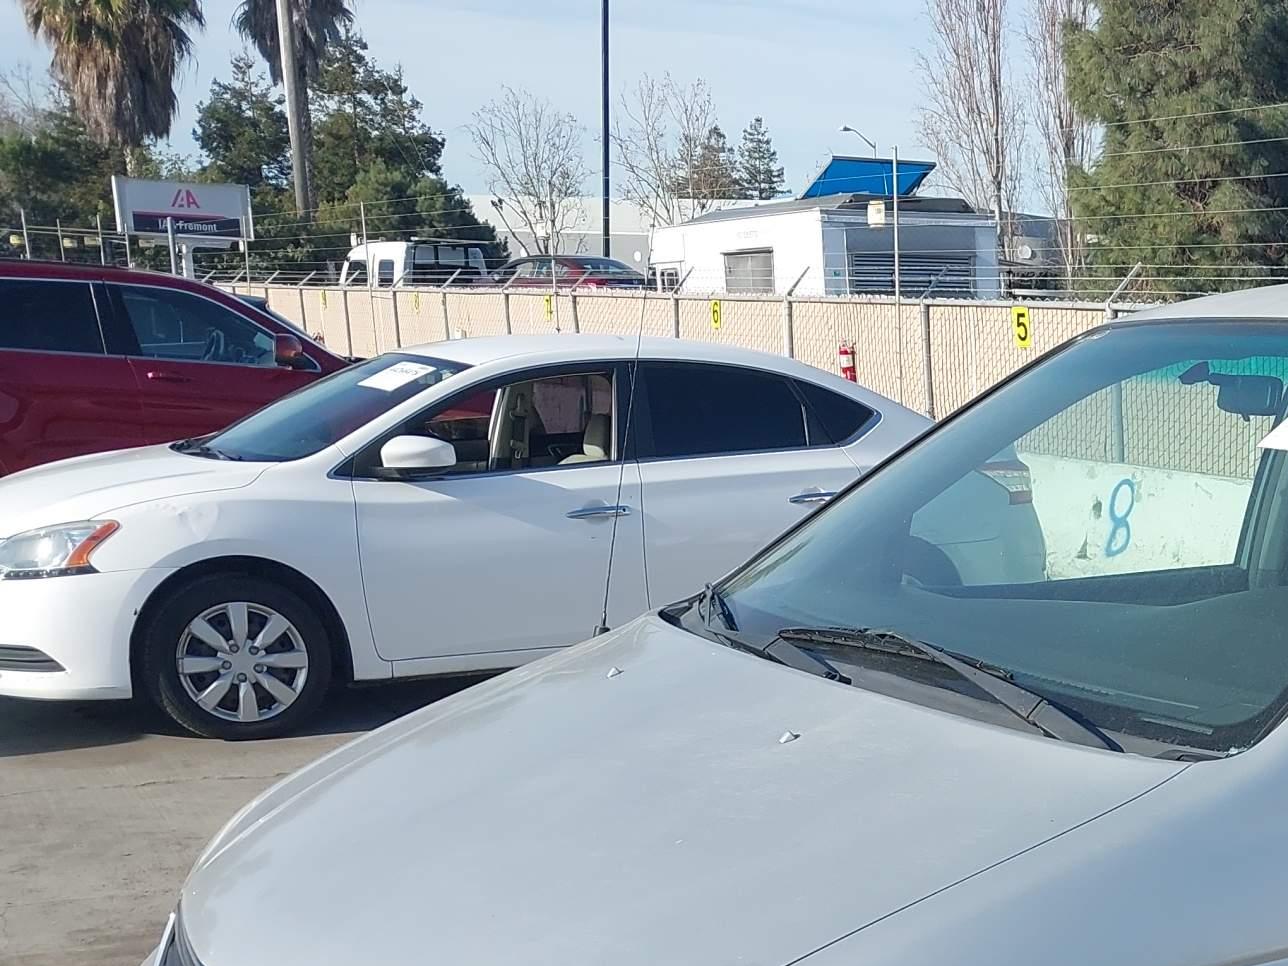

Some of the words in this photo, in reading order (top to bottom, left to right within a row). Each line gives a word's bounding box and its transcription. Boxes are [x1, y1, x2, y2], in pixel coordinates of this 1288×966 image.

[178, 220, 218, 232] Fremont
[712, 302, 719, 324] 6
[1016, 313, 1028, 341] 5
[1105, 478, 1135, 557] 8
